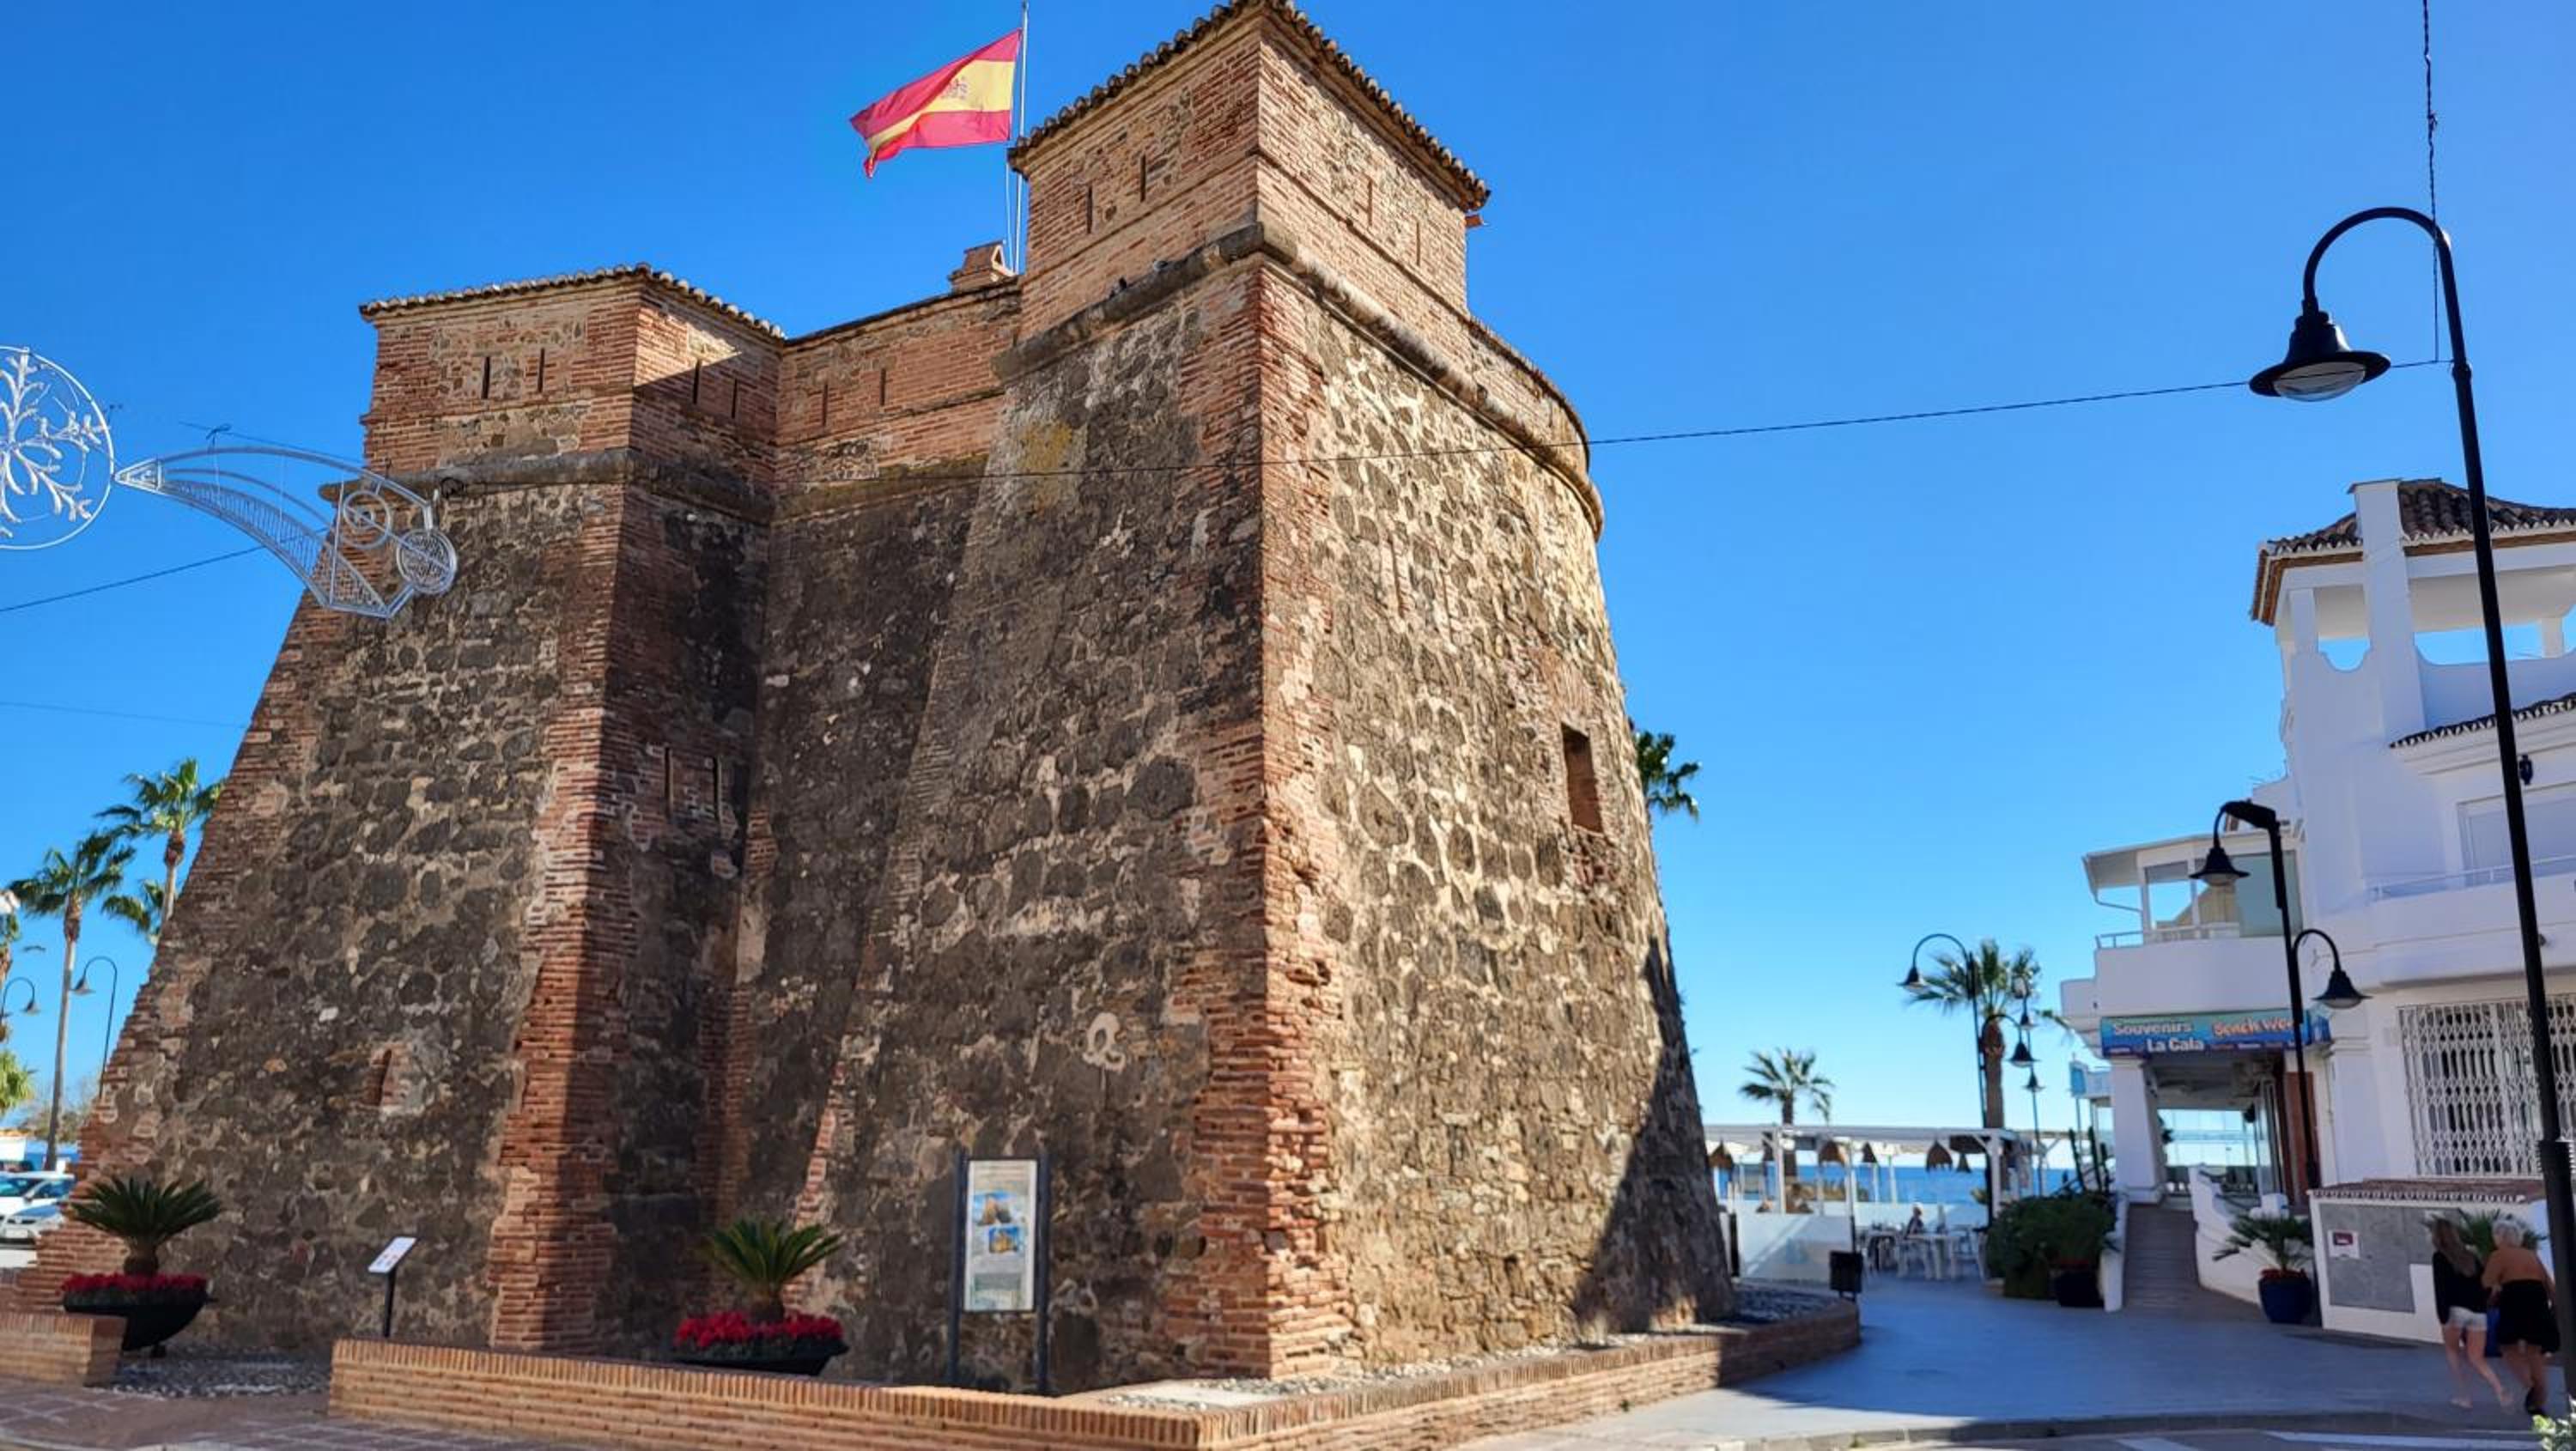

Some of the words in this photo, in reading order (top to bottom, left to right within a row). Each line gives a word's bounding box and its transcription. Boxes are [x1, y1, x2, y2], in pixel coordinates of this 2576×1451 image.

[2113, 1022, 2192, 1036] Souvenirs
[2147, 1038, 2166, 1053] La
[2169, 1036, 2204, 1052] Cala
